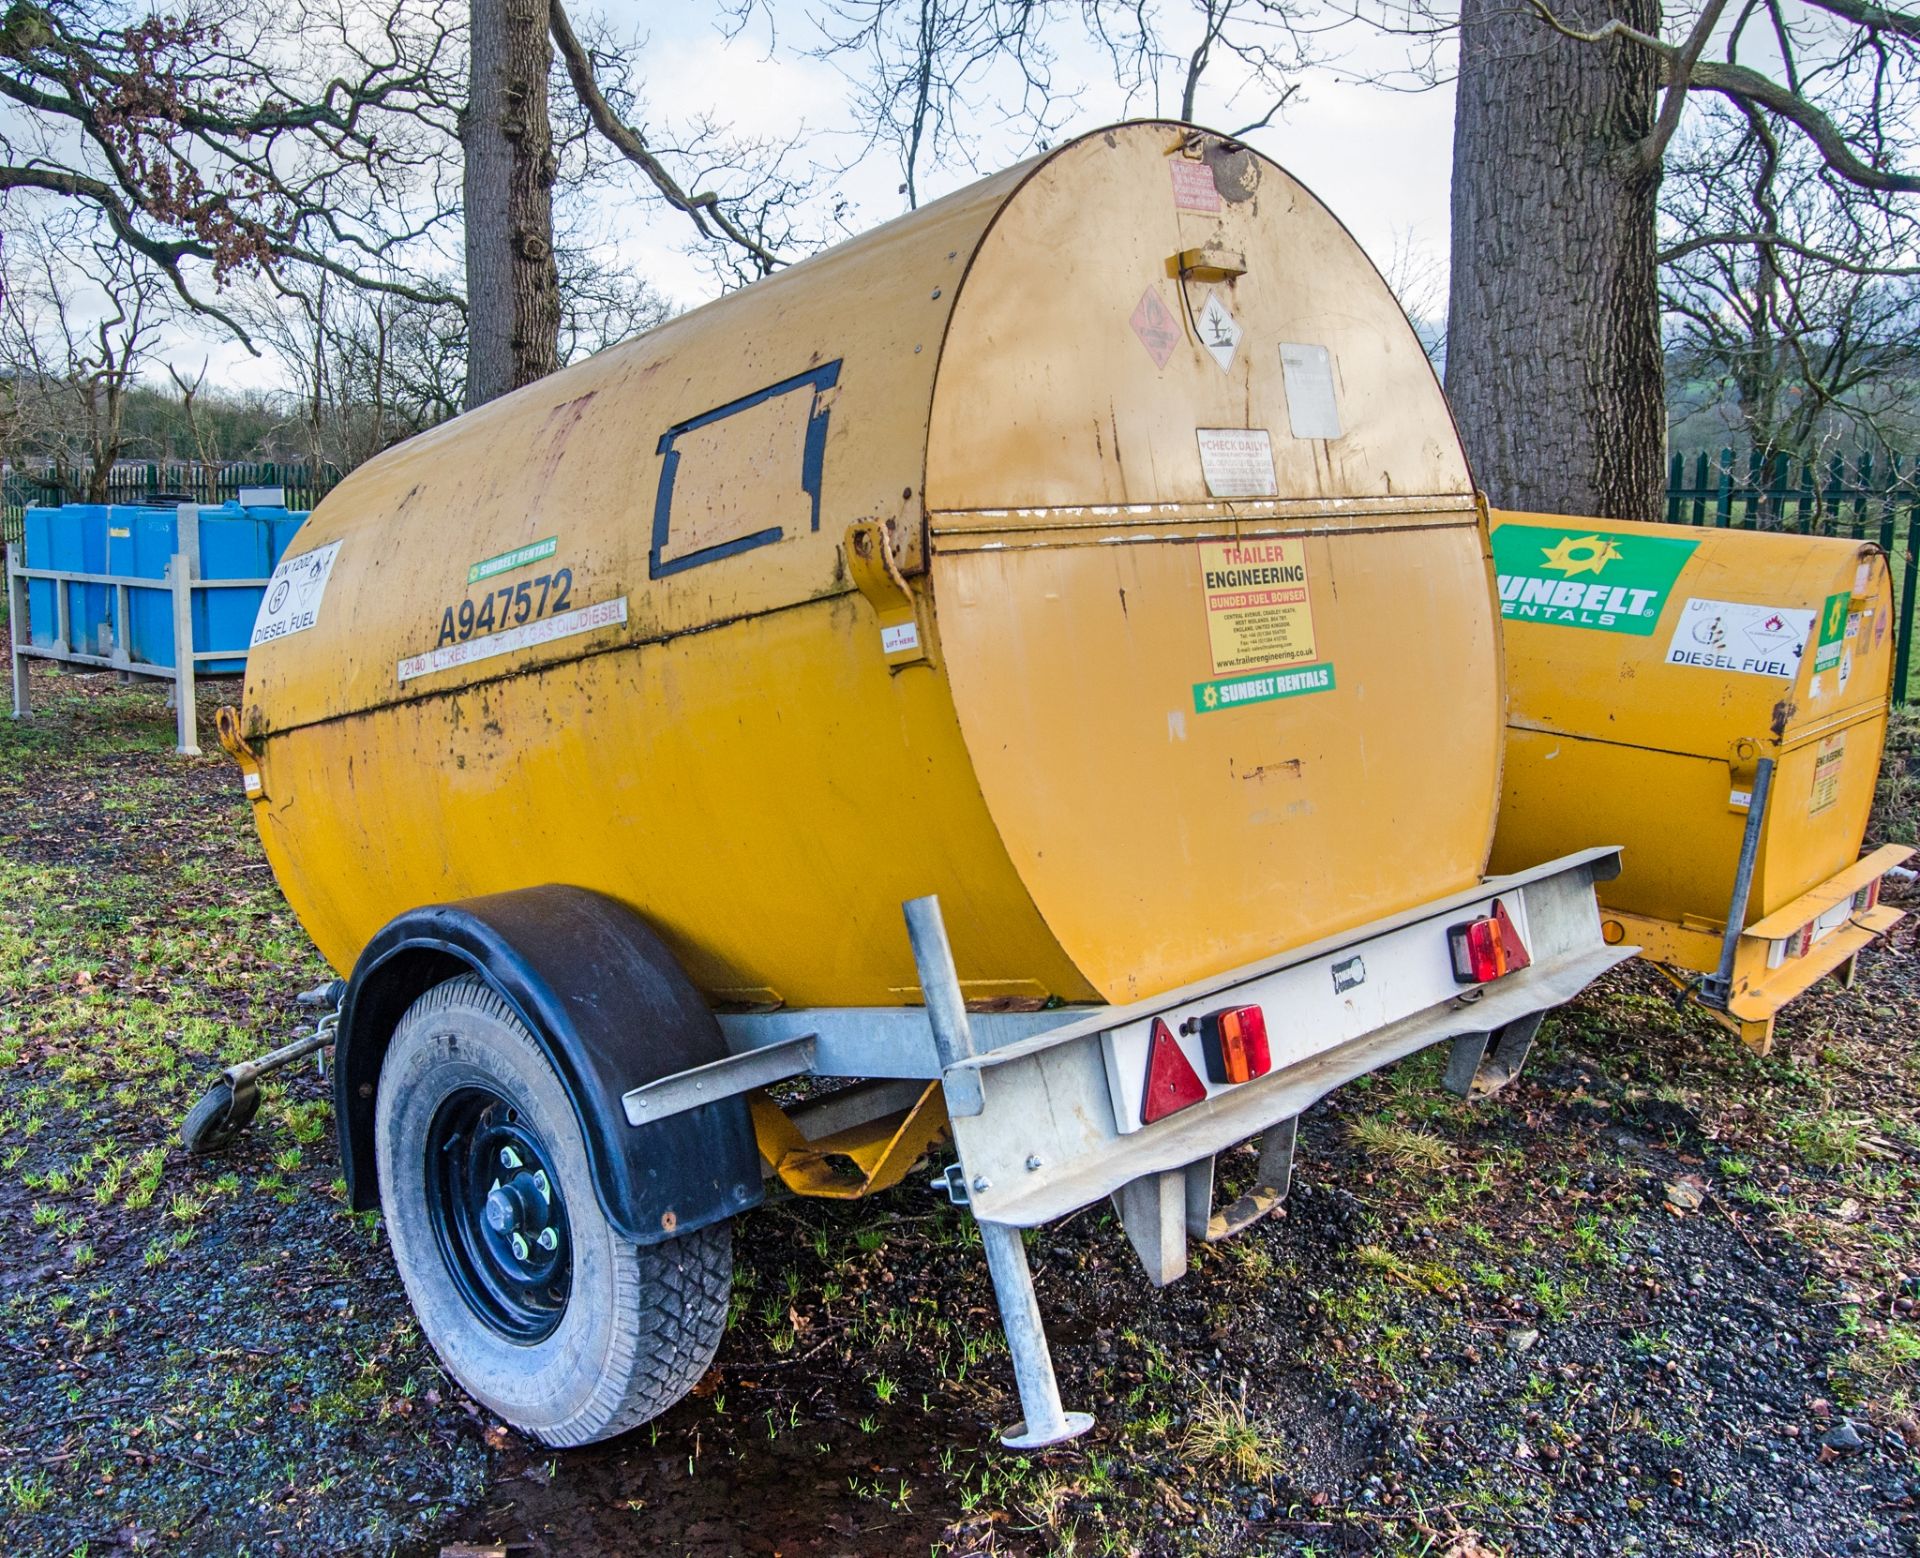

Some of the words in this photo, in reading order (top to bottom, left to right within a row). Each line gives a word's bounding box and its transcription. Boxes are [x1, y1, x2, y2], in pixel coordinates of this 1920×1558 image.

[1207, 440, 1237, 450] CHECK
[1239, 441, 1263, 451] DAILY
[480, 554, 518, 576] SUNBELT
[517, 540, 557, 563] RENTALS
[1223, 545, 1284, 565] TRAILER
[1206, 565, 1304, 589] ENGINEERING
[437, 568, 573, 647] A947572
[1210, 594, 1247, 609] BUNDED
[1248, 592, 1269, 605] FUEL
[1271, 590, 1305, 604] BOWSER
[1497, 575, 1658, 616] UNBELT
[1501, 602, 1616, 626] ENTALS
[254, 620, 287, 644] DIESEL
[289, 611, 314, 632] FUEL
[405, 657, 426, 676] 2140
[1216, 648, 1313, 668] www.trailerengineering.co.uk
[1672, 649, 1737, 669] DIESEL
[1742, 658, 1790, 676] FUEL
[1219, 677, 1275, 703] SUNBELT
[1276, 669, 1329, 693] RENTALS
